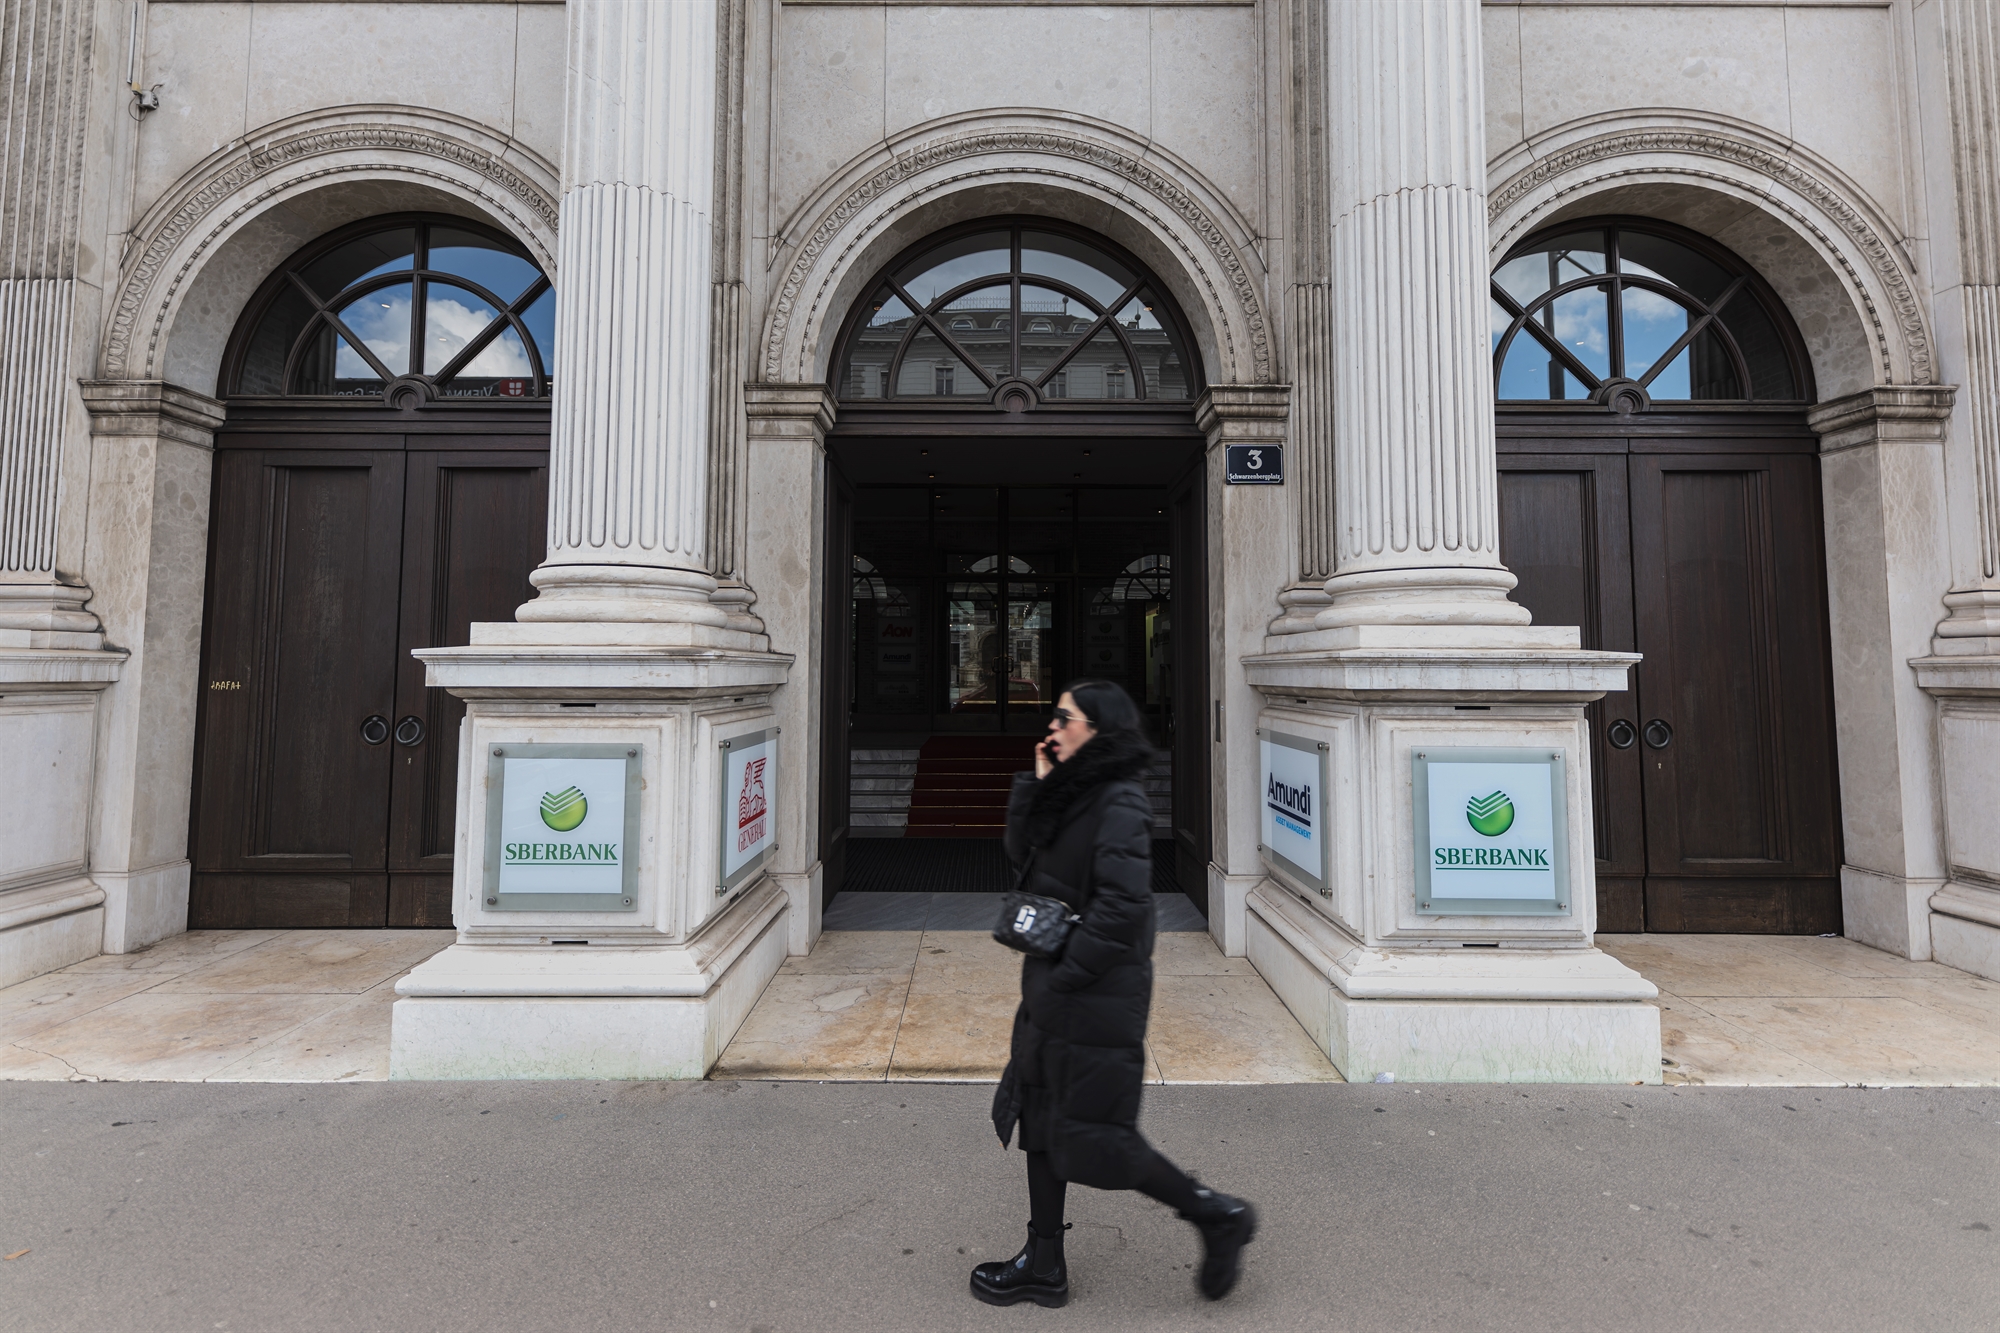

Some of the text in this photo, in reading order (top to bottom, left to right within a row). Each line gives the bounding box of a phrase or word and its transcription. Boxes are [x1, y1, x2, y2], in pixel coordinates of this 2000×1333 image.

[1246, 449, 1263, 470] 3
[1229, 472, 1281, 481] Schwarzenbergplatz
[882, 623, 913, 637] AON
[1267, 772, 1311, 816] Amundi
[738, 818, 767, 853] GENERALI
[1275, 815, 1311, 840] ASSET MANAGEMENT
[505, 843, 618, 861] SBERBANK
[1434, 847, 1550, 866] SBERBANK
